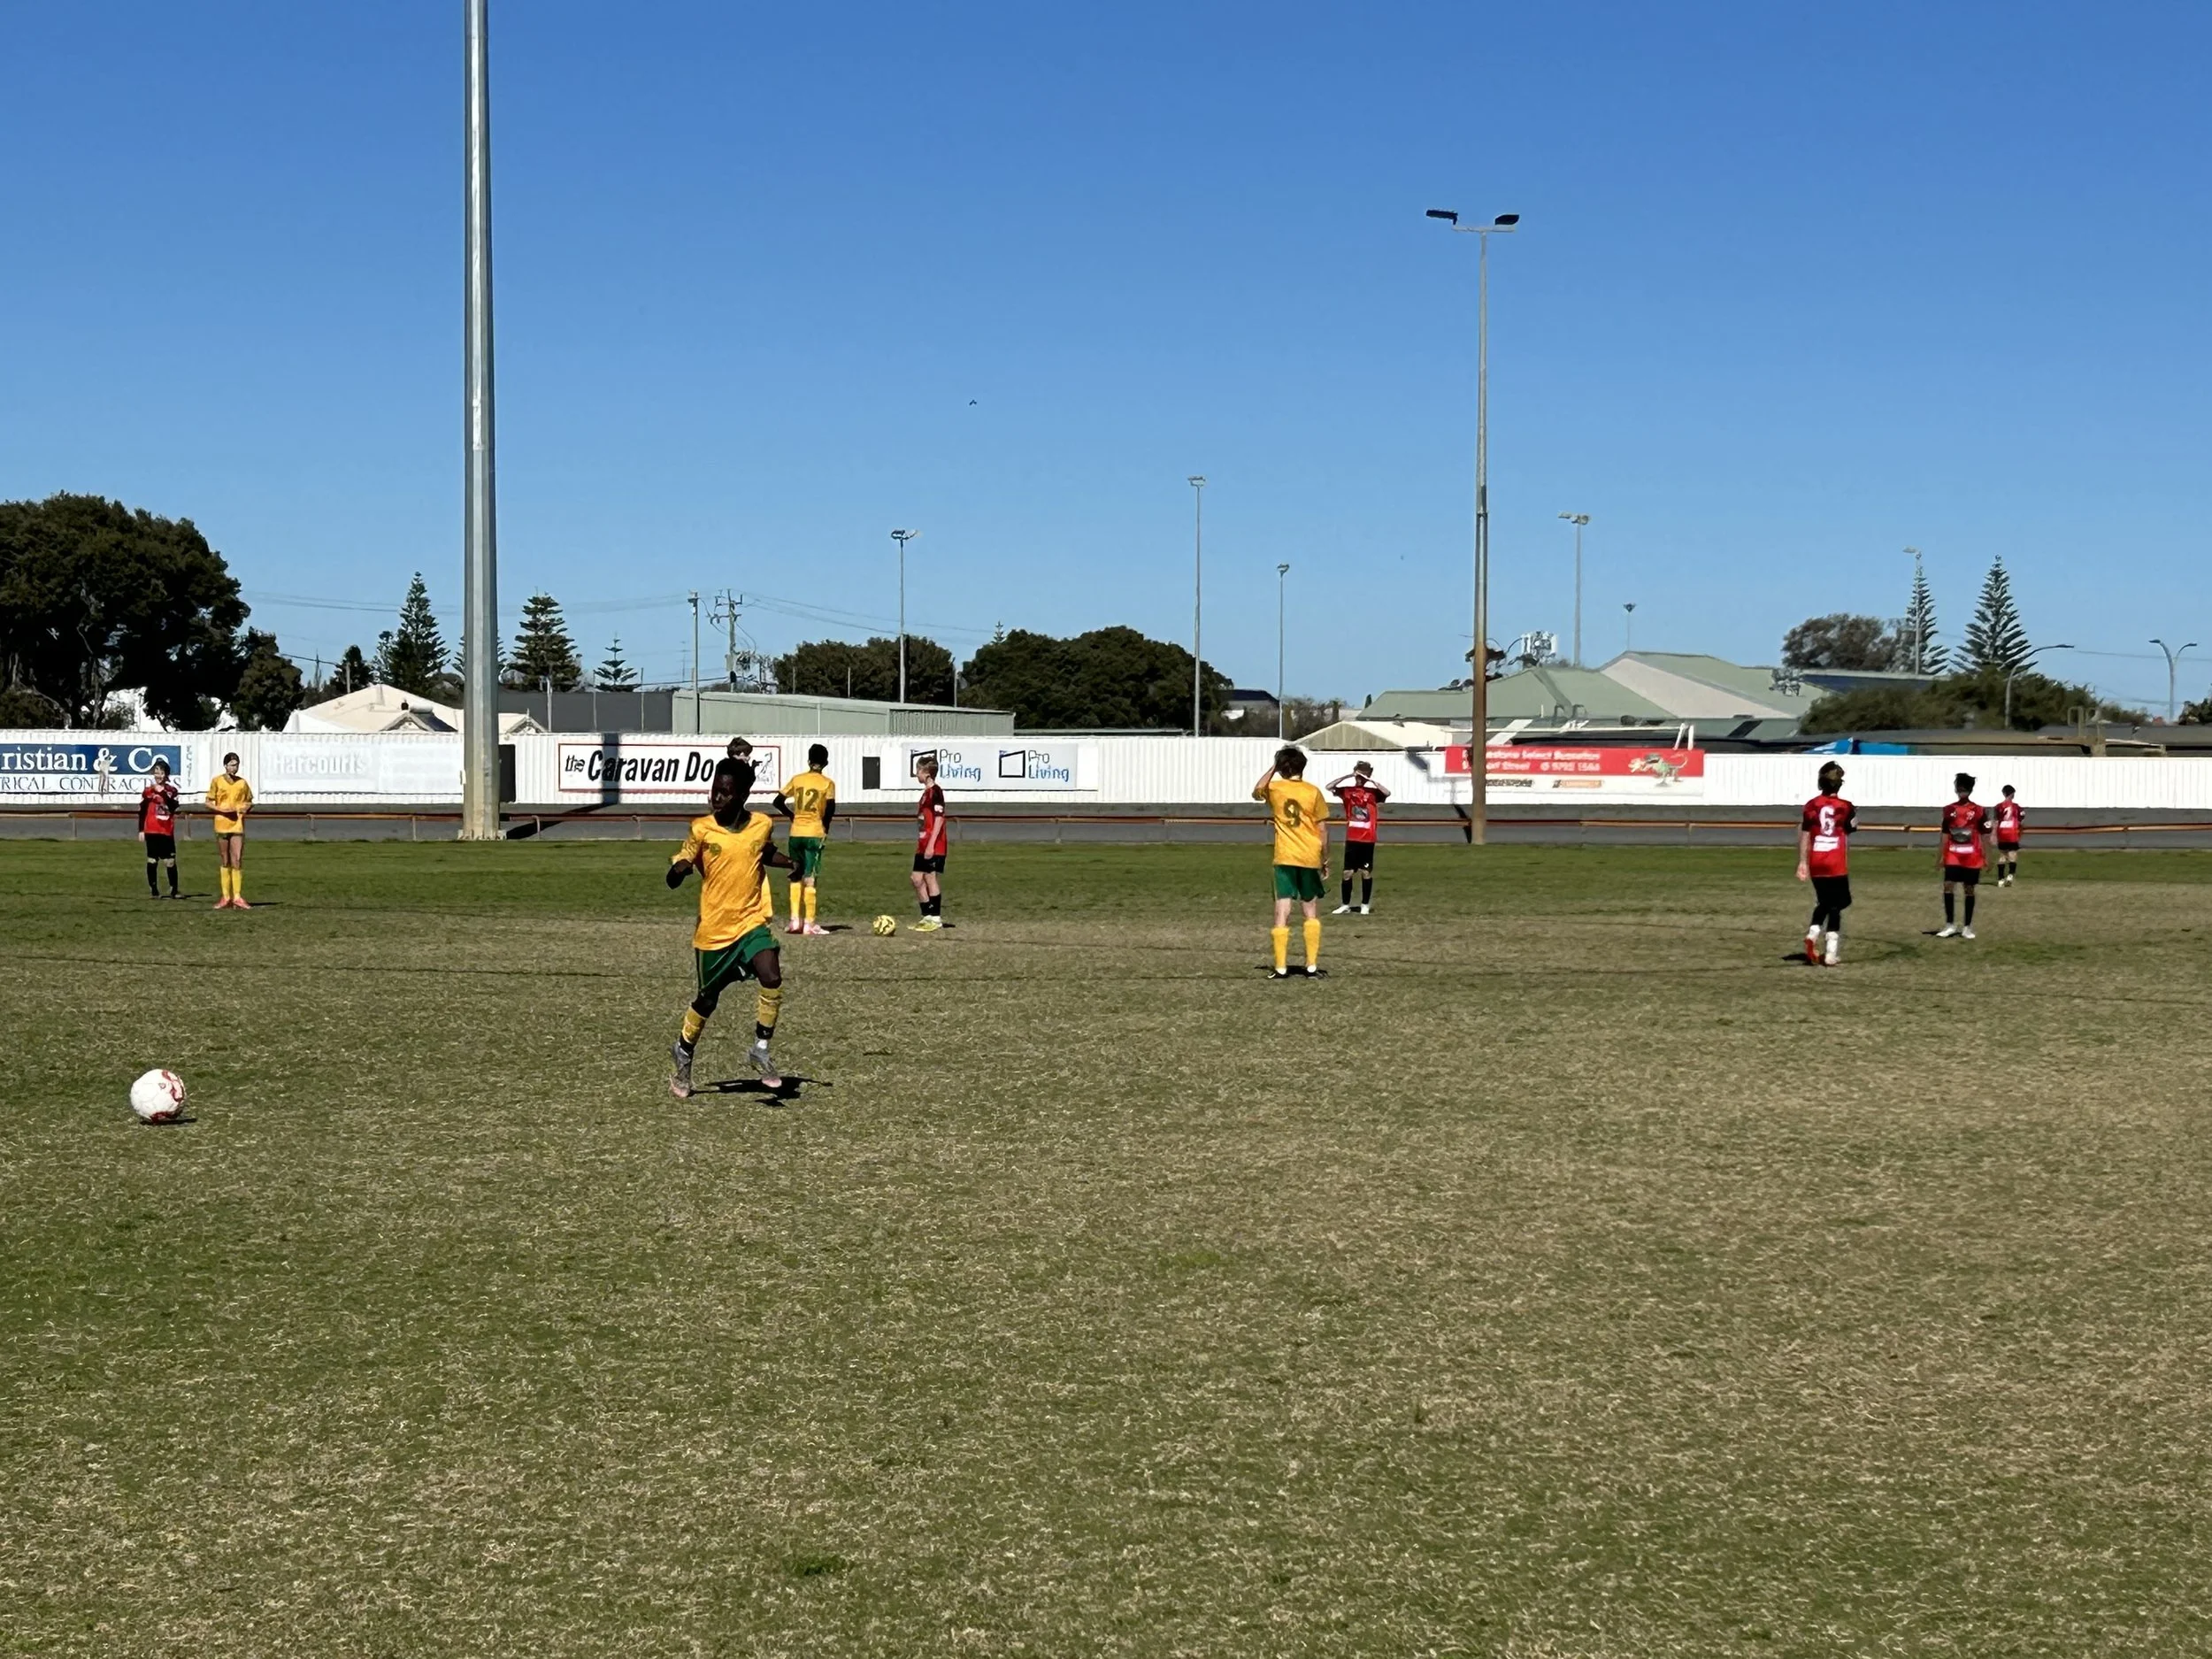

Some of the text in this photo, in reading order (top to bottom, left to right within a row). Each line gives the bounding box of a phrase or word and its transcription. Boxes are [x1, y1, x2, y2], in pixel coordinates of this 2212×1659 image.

[1, 745, 88, 772] ristian
[93, 748, 118, 772] &
[565, 755, 585, 772] the
[588, 750, 680, 782] Caravan
[939, 749, 962, 764] Pro
[1027, 750, 1050, 764] Pro
[0, 776, 50, 790] RICAL
[939, 764, 981, 782] Living
[1028, 764, 1070, 783] Living
[795, 787, 818, 812] 12
[1284, 798, 1301, 828] 9
[1819, 805, 1835, 836] 6
